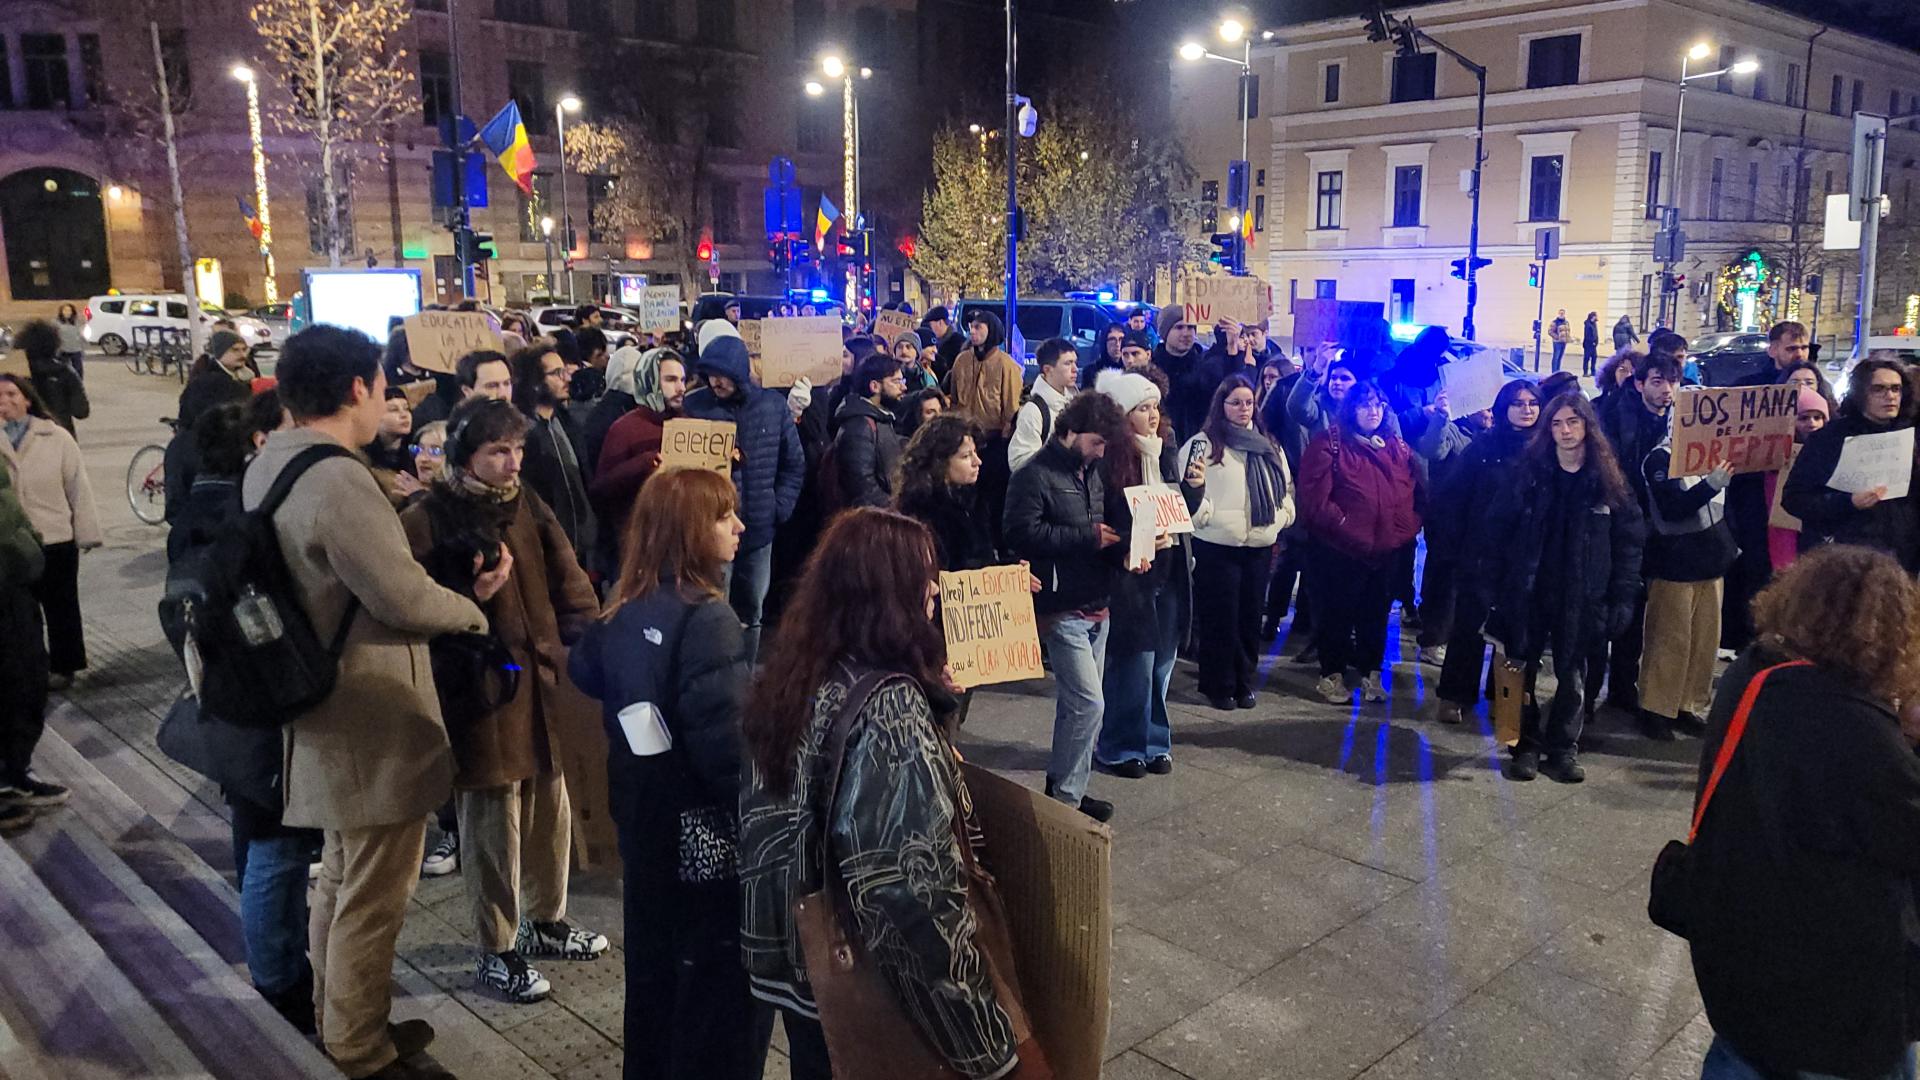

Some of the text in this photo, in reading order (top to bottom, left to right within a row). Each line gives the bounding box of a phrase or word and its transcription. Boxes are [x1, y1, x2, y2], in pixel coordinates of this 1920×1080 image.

[1186, 303, 1211, 323] NU
[1681, 386, 1799, 428] JOS MÂNA
[1717, 423, 1755, 437] DE PE
[941, 575, 965, 604] Drept
[968, 575, 981, 601] la
[944, 601, 1004, 646] INDIFERENT
